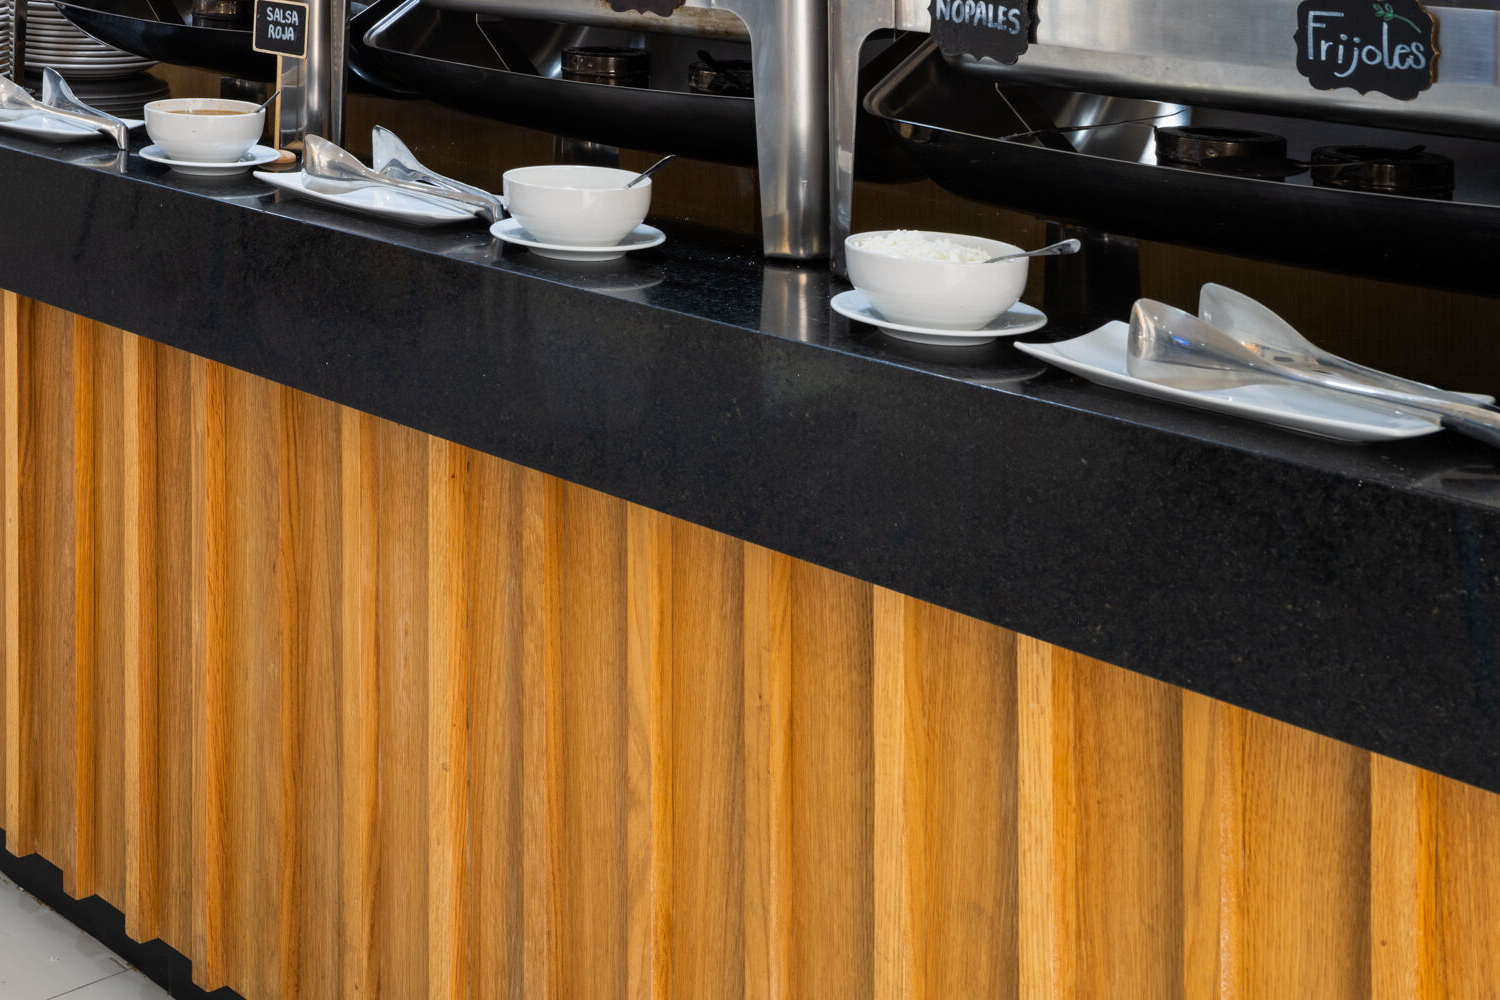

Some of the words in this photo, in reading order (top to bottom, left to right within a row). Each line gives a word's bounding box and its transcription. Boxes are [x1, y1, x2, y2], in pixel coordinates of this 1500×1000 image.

[266, 7, 299, 25] SALSA
[268, 26, 295, 41] ROJA
[1307, 10, 1426, 78] Frijoles
